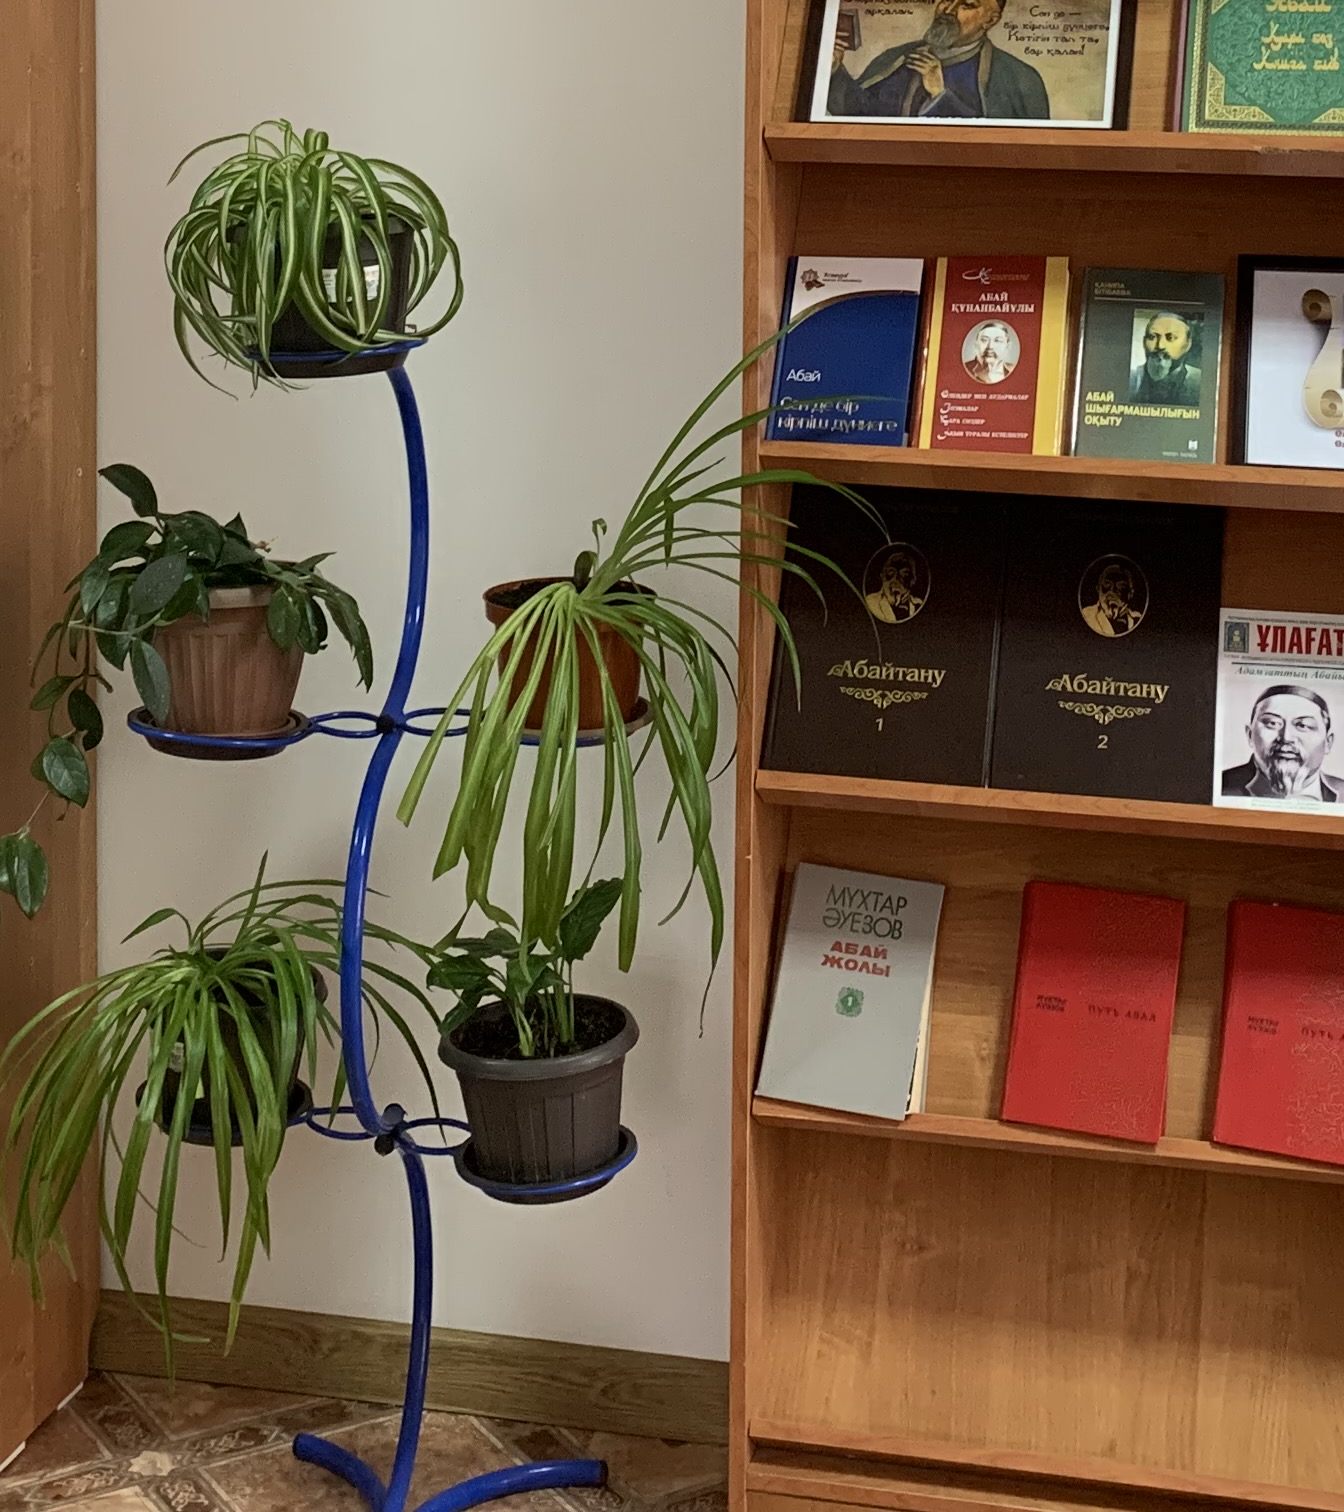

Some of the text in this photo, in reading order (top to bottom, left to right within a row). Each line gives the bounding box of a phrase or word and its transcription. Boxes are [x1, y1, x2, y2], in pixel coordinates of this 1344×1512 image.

[979, 292, 1008, 302] АБАЙ
[786, 369, 822, 382] Абай
[1086, 391, 1115, 401] АБАЙ
[1084, 415, 1122, 427] ОҚЫТУ
[827, 659, 946, 689] Абайтану
[1045, 672, 1169, 705] Абайтану
[874, 718, 885, 733] 1
[1096, 734, 1109, 749] 2
[822, 907, 904, 941] ӘУЕЗОВ
[830, 940, 888, 960] АБАЙ
[821, 954, 891, 978] ЖОЛЫ
[847, 996, 854, 1007] 1
[1088, 1004, 1119, 1017] ПУТЬ
[1301, 1026, 1335, 1041] ПУТЬ
